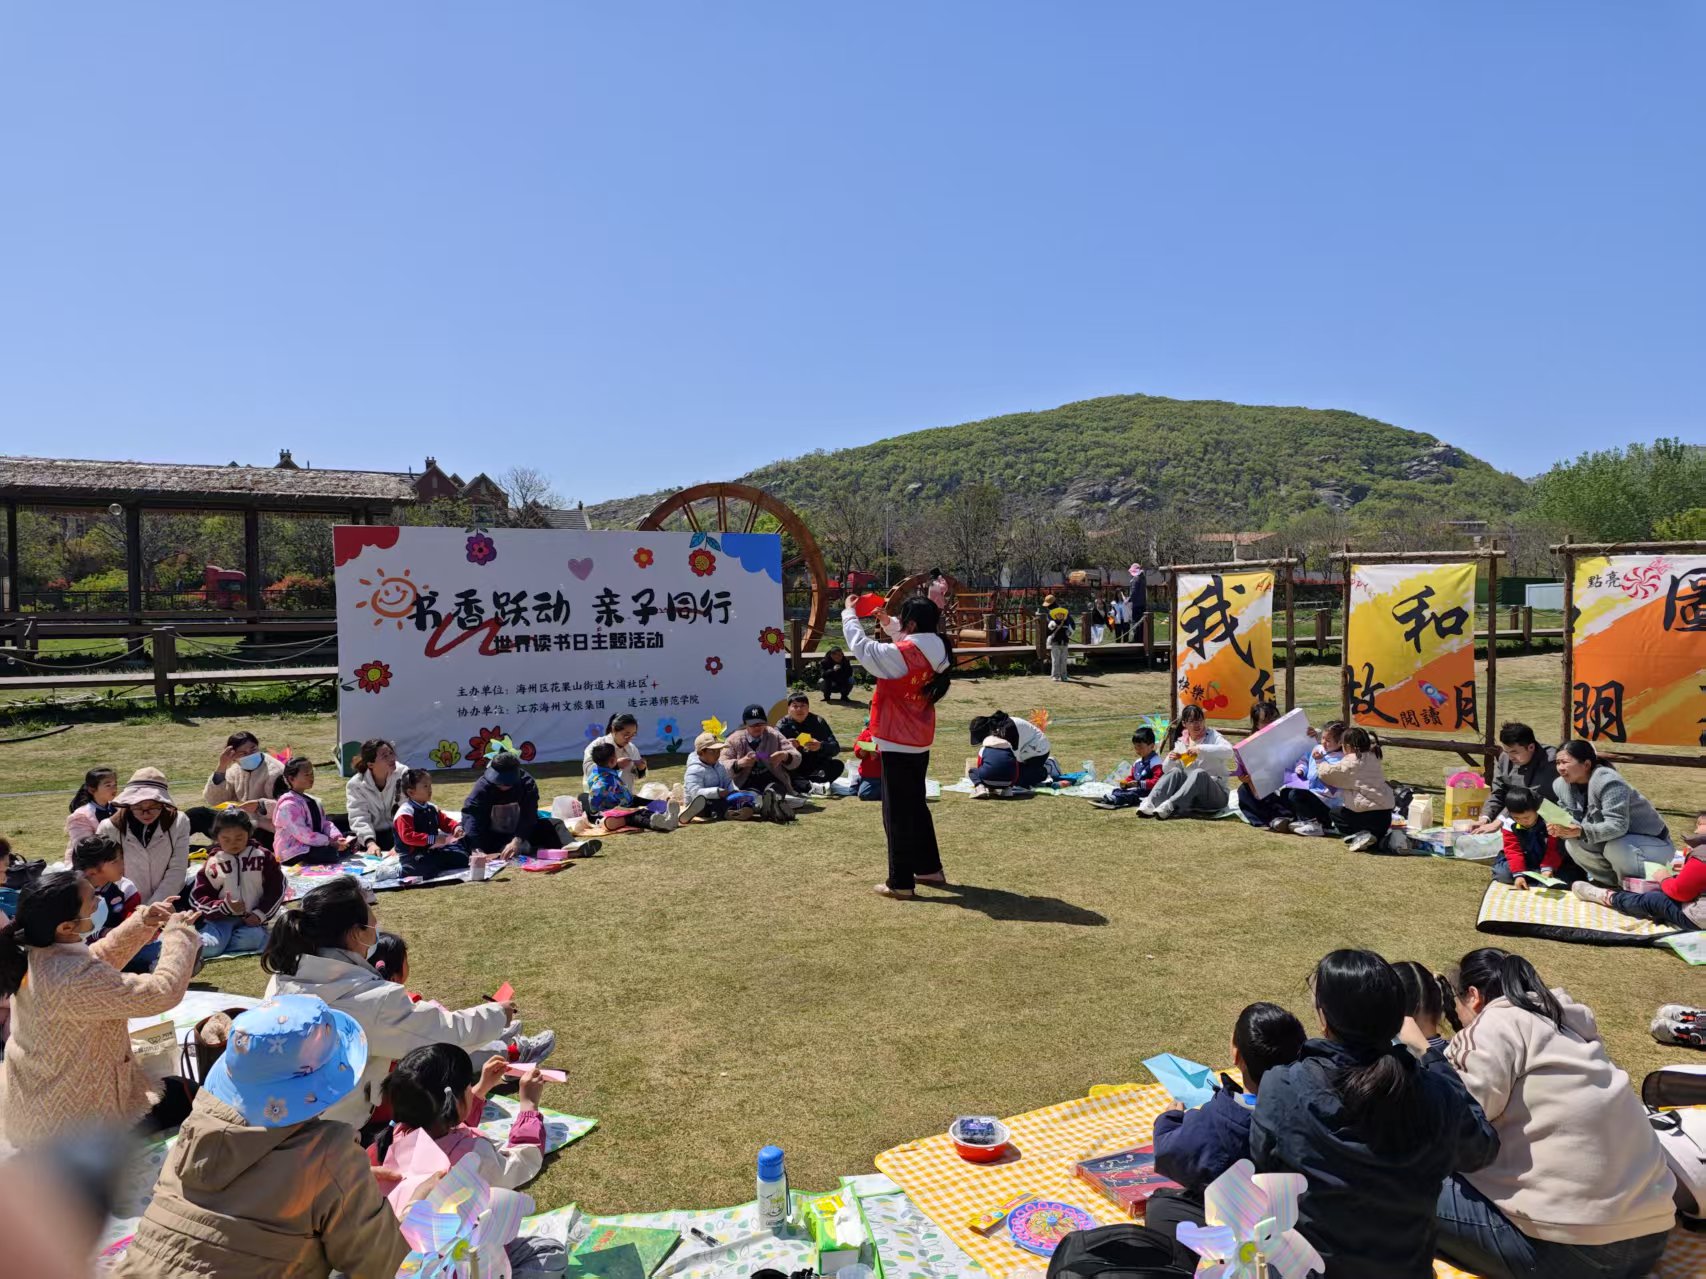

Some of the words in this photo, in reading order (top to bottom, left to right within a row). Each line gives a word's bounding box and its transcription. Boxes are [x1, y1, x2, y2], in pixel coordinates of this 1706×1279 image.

[407, 588, 571, 632] 书香跃动
[592, 587, 732, 628] 亲子同行
[1180, 574, 1256, 669] 我
[1392, 585, 1469, 654] 和
[494, 631, 664, 653] 世界读书日主题活动
